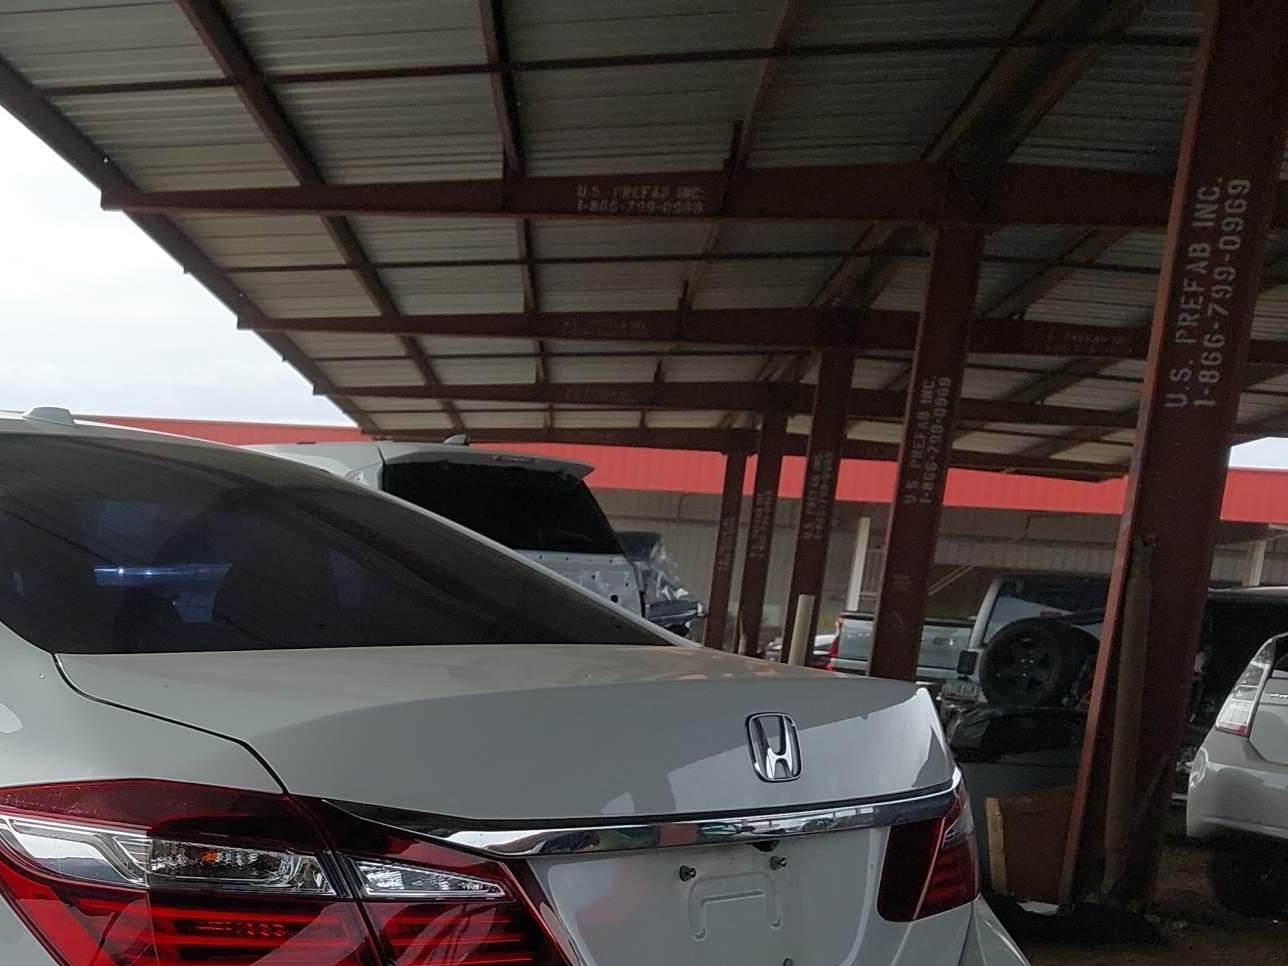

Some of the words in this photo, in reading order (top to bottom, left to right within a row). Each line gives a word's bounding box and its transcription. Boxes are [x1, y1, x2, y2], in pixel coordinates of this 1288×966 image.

[1191, 175, 1224, 228] INC.
[1174, 242, 1211, 345] PREFAB
[1193, 177, 1251, 408] 1-866-799-0969
[1164, 360, 1195, 408] U.S.
[908, 411, 931, 469] PREFAB
